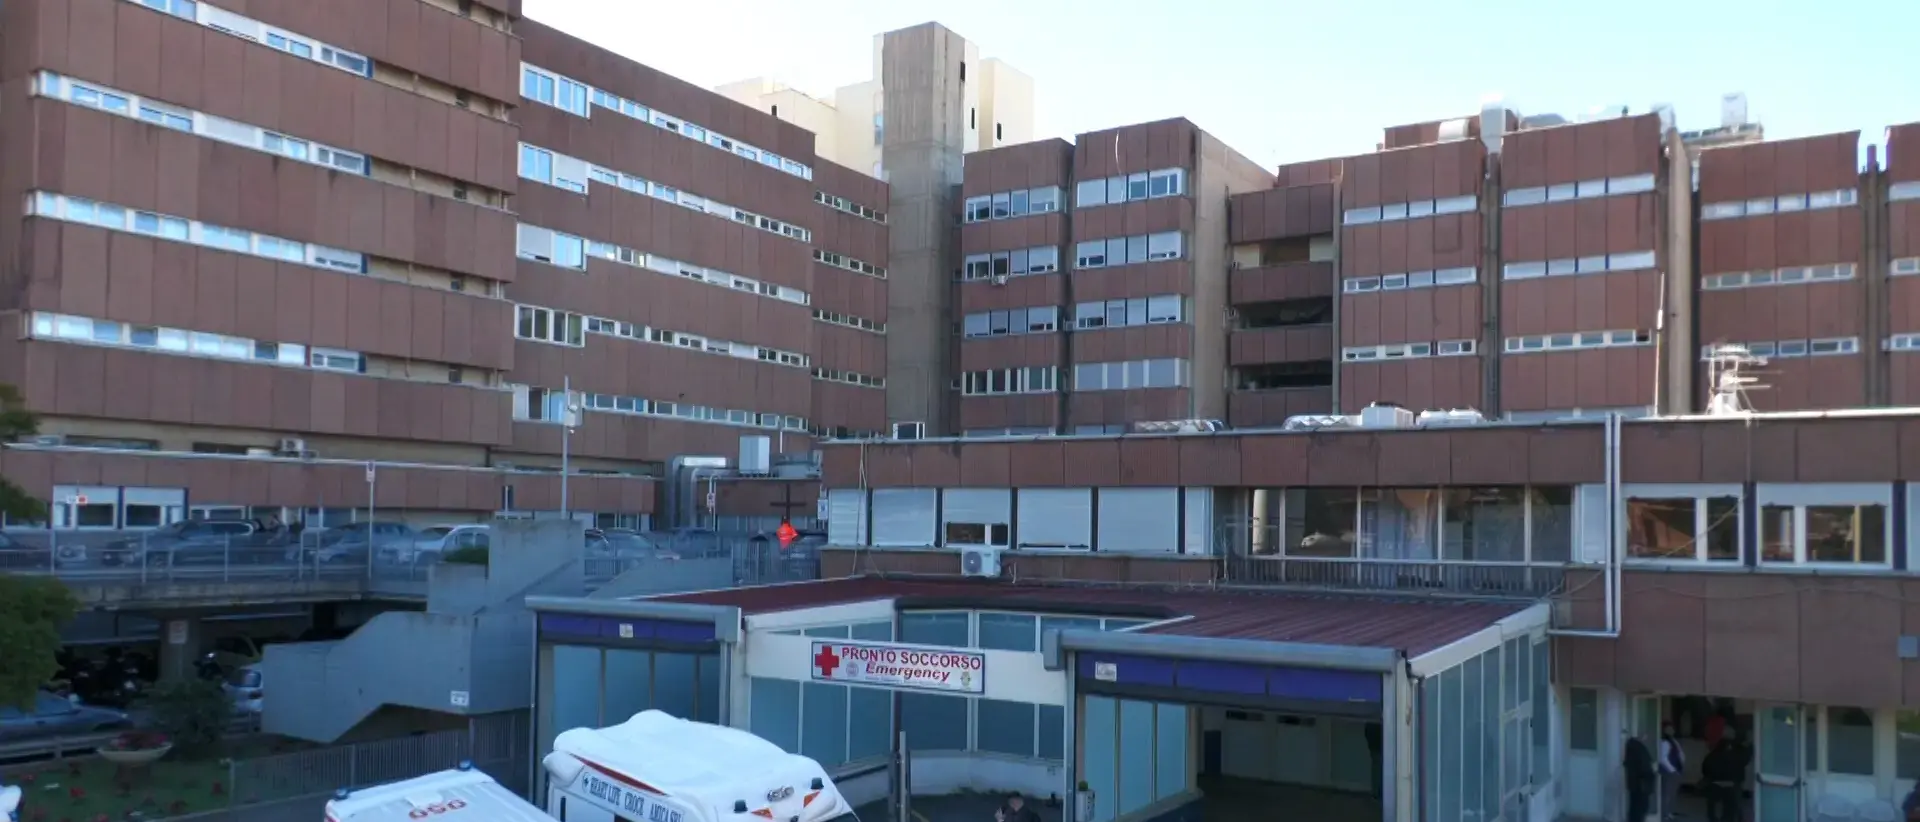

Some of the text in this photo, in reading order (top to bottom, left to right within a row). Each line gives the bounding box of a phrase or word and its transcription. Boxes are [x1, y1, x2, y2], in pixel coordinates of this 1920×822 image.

[842, 647, 981, 671] PRONTO SOCCORSO
[866, 662, 951, 682] Emergency
